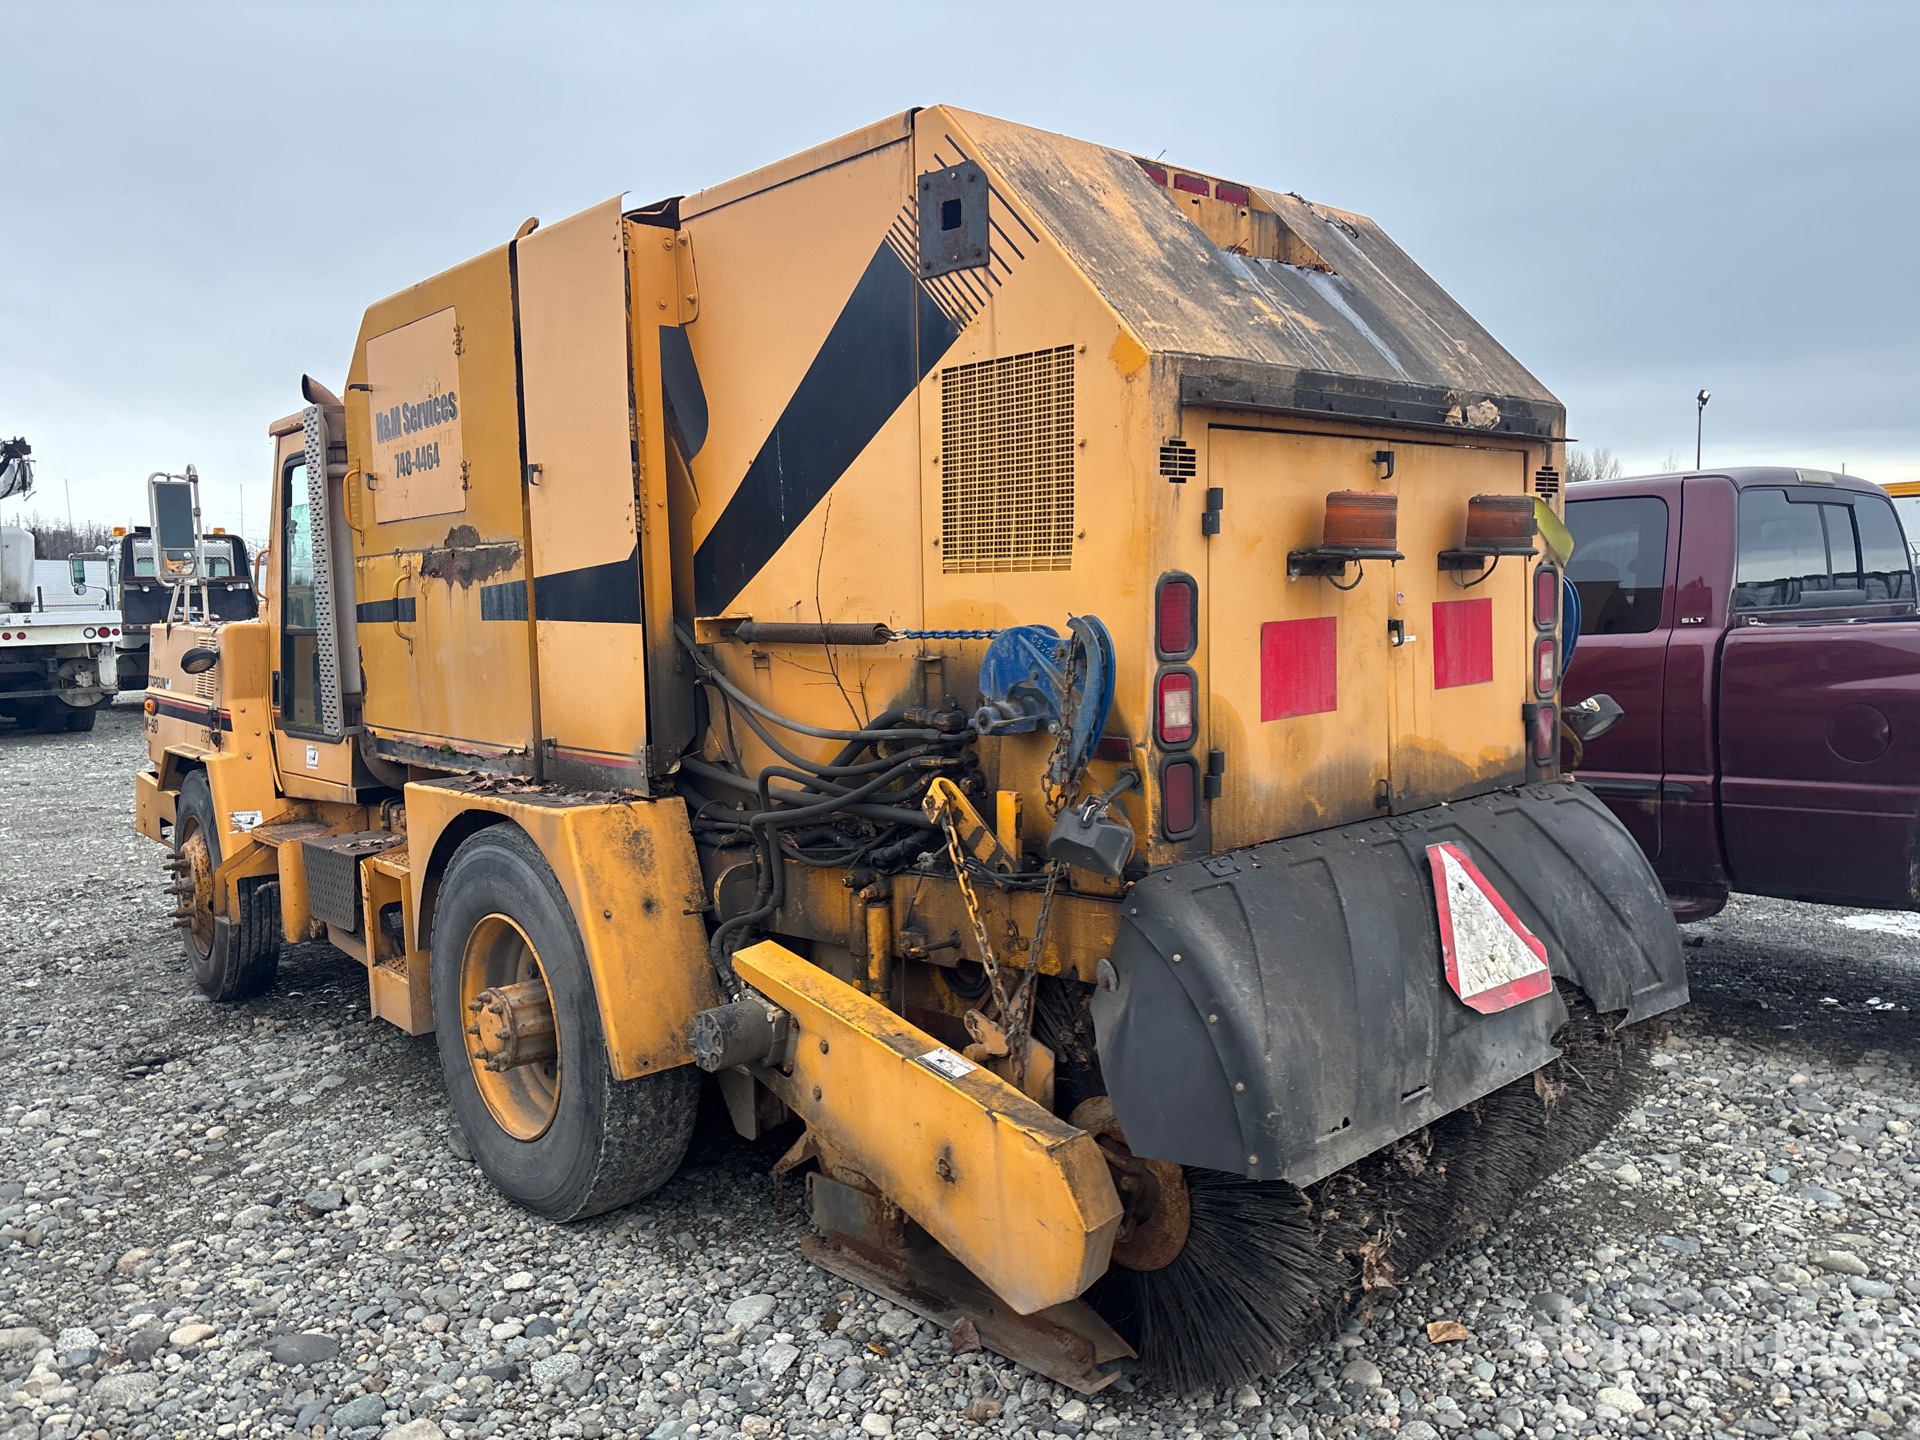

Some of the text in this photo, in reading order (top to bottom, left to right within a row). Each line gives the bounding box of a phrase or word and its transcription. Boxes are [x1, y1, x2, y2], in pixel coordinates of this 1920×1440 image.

[376, 405, 402, 444] H&M
[402, 391, 458, 434] Services
[394, 441, 440, 478] 748-4464
